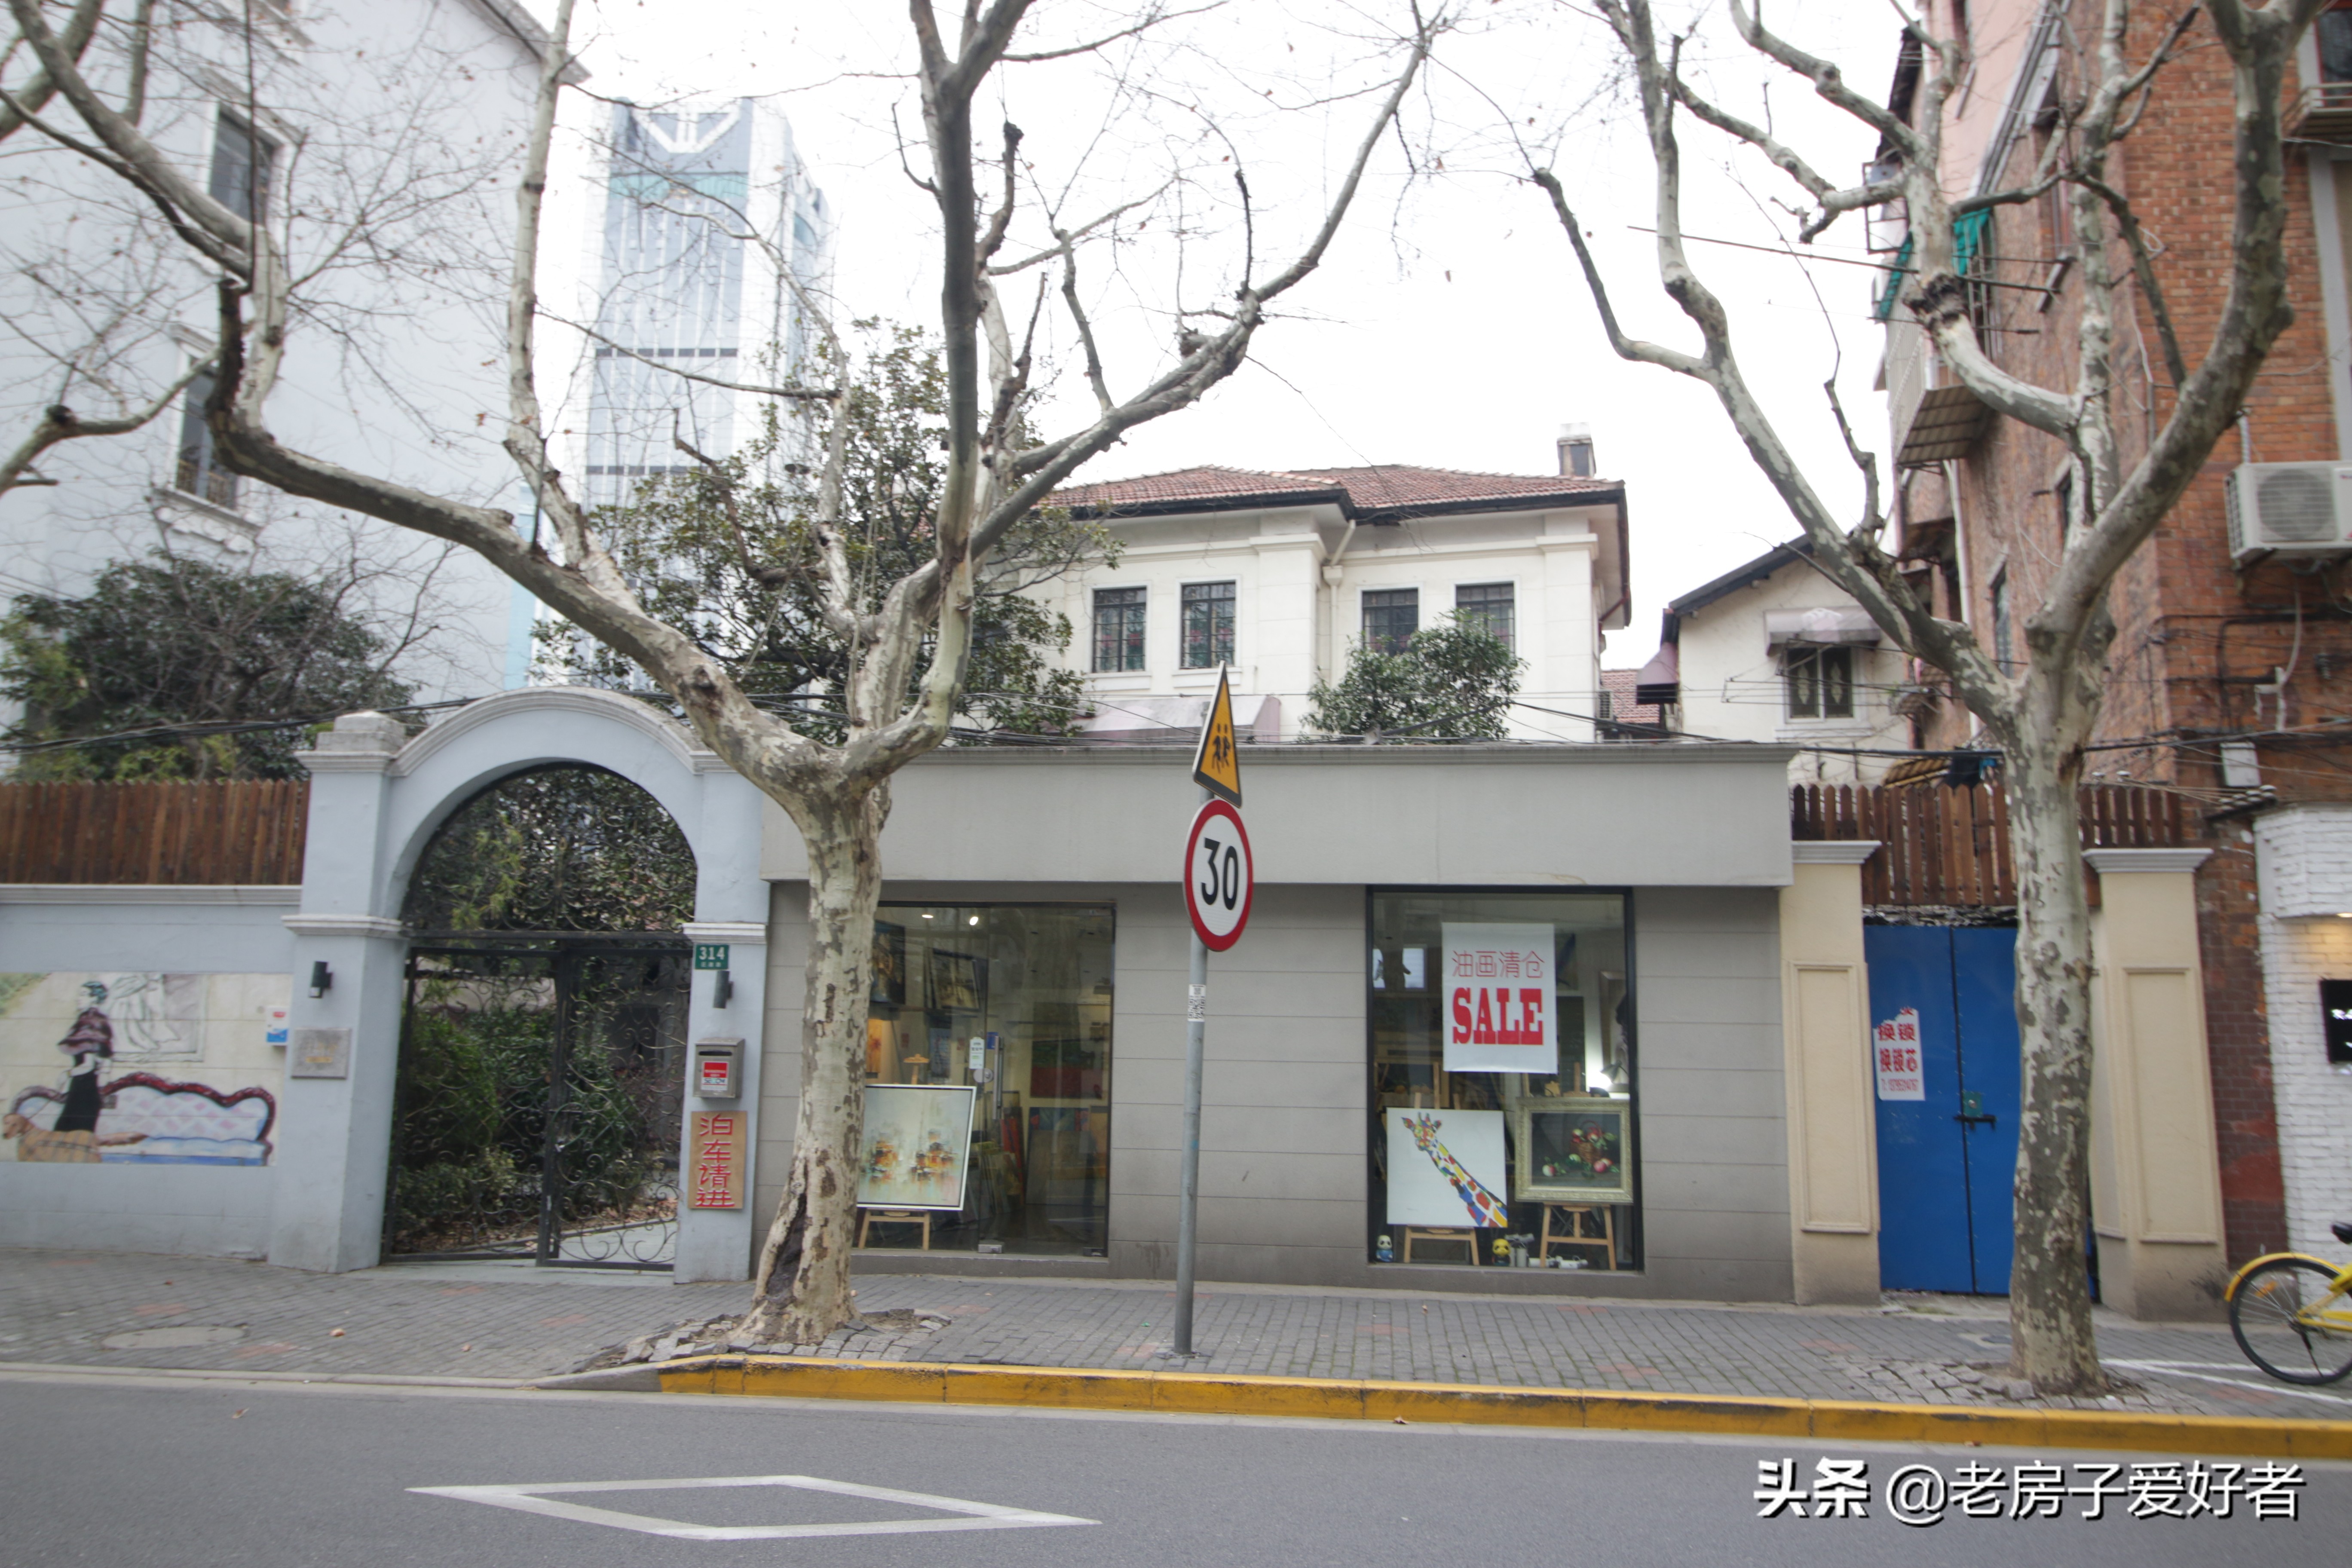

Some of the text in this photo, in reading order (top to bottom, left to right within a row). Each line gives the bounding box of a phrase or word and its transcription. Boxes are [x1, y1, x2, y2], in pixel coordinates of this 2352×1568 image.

[1201, 838, 1238, 910] 30
[698, 946, 726, 960] 314
[1452, 950, 1544, 978] 油画清仓
[1453, 987, 1543, 1045] SALE
[696, 1114, 735, 1208] 泊车请进
